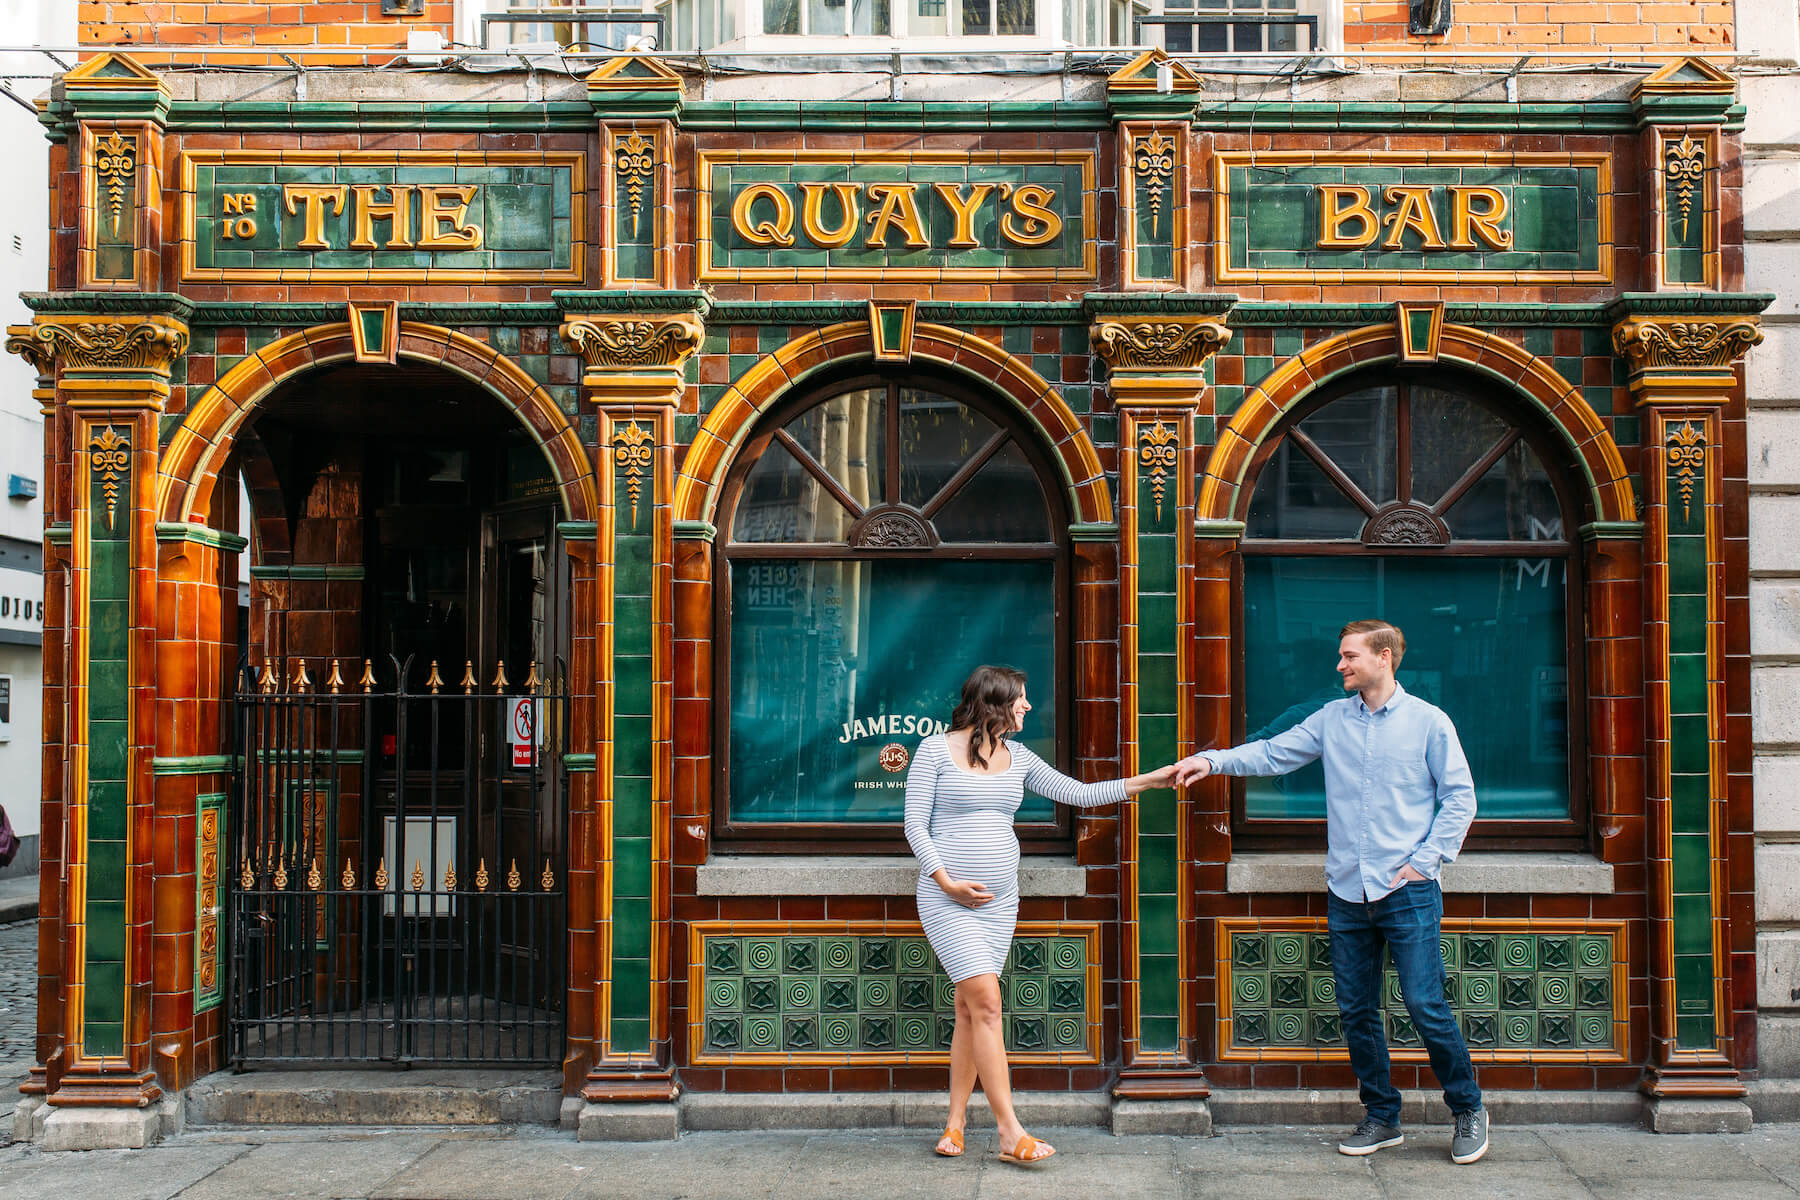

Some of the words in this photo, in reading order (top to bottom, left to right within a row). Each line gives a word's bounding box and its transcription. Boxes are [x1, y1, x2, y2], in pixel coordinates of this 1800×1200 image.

[222, 218, 257, 239] 10
[283, 183, 484, 249] THE
[731, 182, 1064, 248] QUAY'S
[1316, 184, 1512, 250] BAR
[838, 714, 952, 744] JAMESON
[854, 781, 883, 789] IRISH
